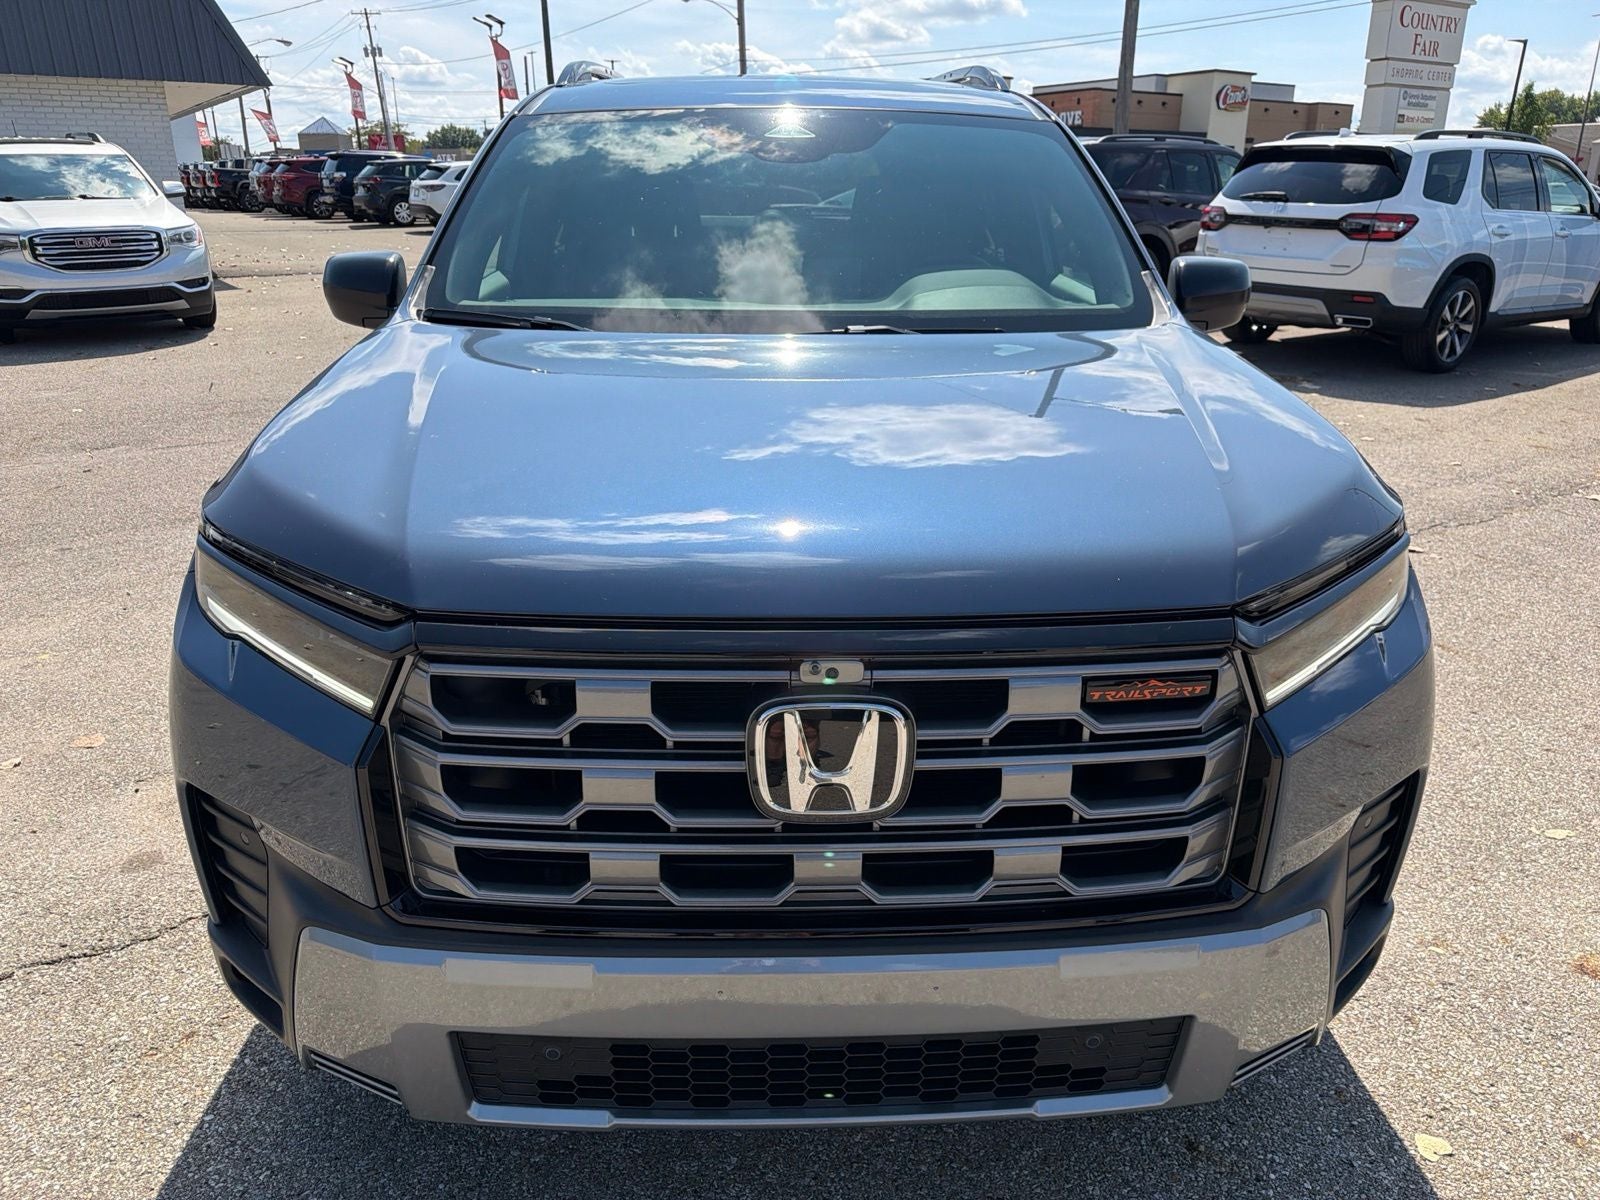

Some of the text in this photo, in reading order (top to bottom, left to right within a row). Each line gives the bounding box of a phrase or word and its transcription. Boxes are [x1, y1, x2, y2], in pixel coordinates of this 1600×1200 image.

[1400, 5, 1460, 33] COUNTRY
[1412, 33, 1439, 57] FAIR
[1391, 67, 1452, 82] SHOPPING CENTER
[74, 236, 121, 249] GMC
[1090, 686, 1206, 701] TRAILSPORT
